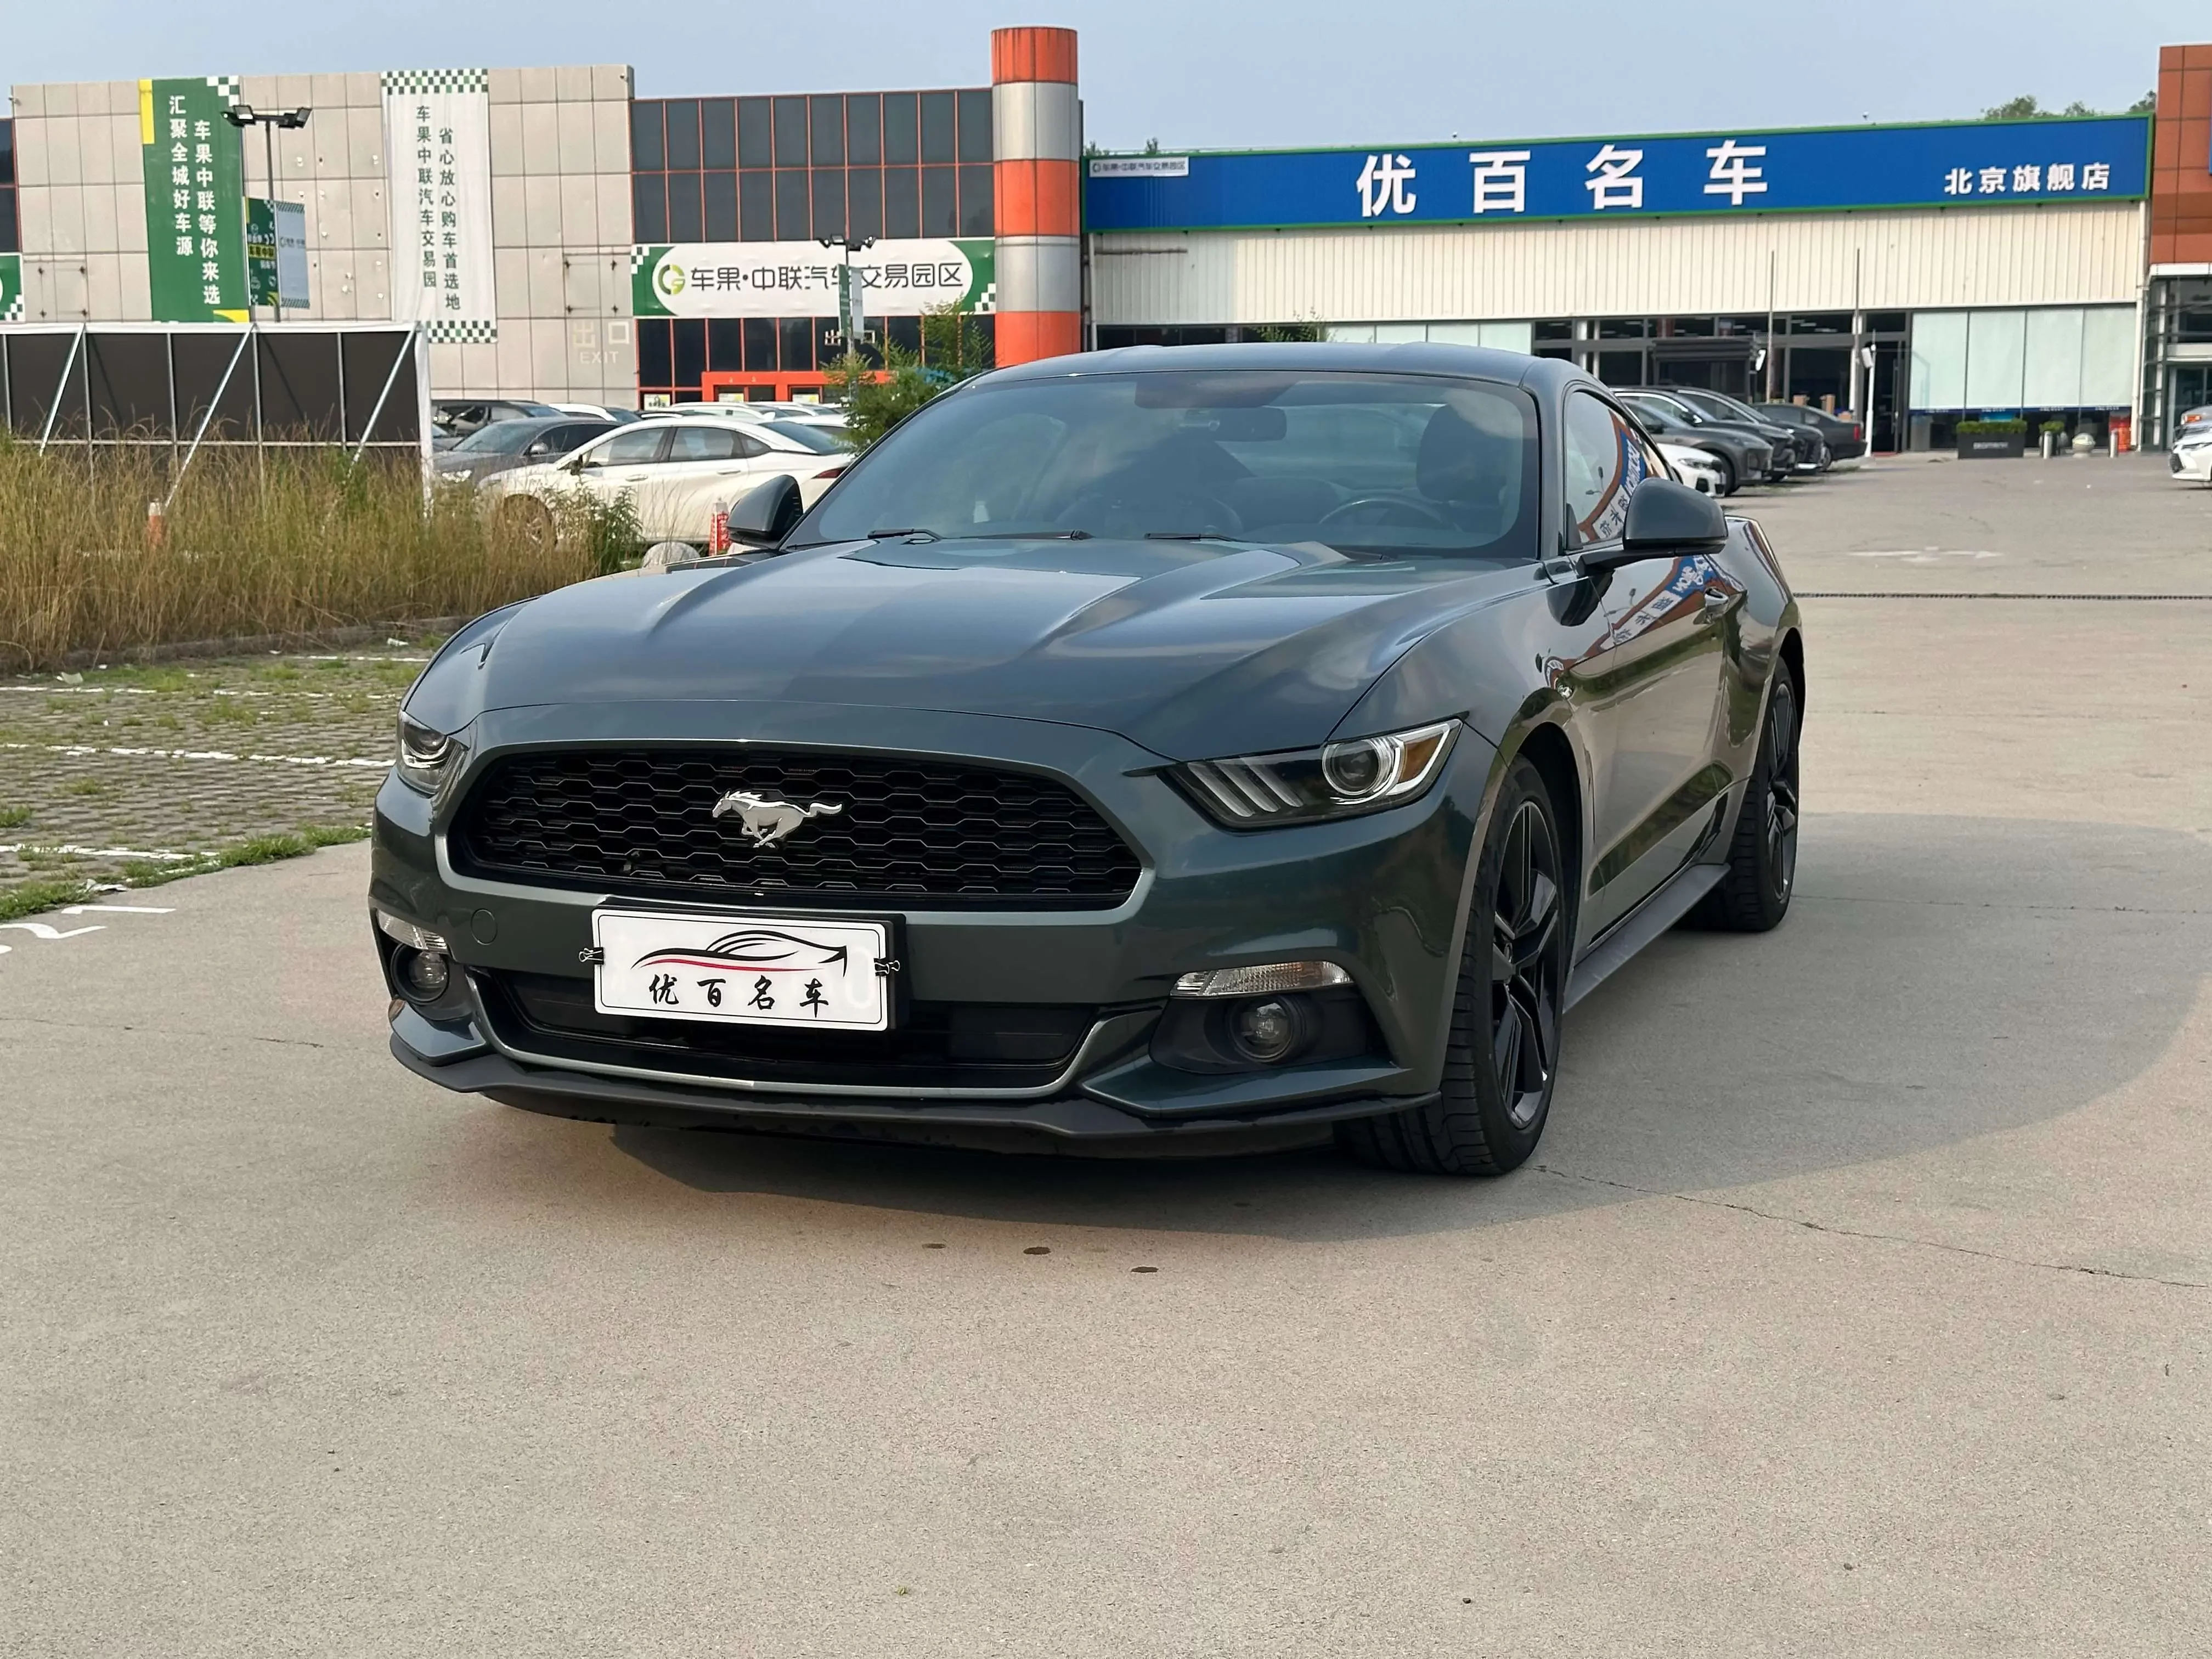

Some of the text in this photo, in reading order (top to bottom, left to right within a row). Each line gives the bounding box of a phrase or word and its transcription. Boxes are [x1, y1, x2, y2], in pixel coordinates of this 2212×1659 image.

[169, 95, 194, 256] 汇聚全城好车源
[194, 120, 221, 305] 车果中联等你来选
[416, 105, 437, 288] 车果中联汽车交易园
[439, 127, 461, 311] 省心放心购车首选地
[1356, 139, 1768, 217] 优百名车
[1944, 163, 2110, 194] 北京旗舰店
[580, 351, 619, 363] EXIT
[649, 974, 829, 1018] 优百名车
